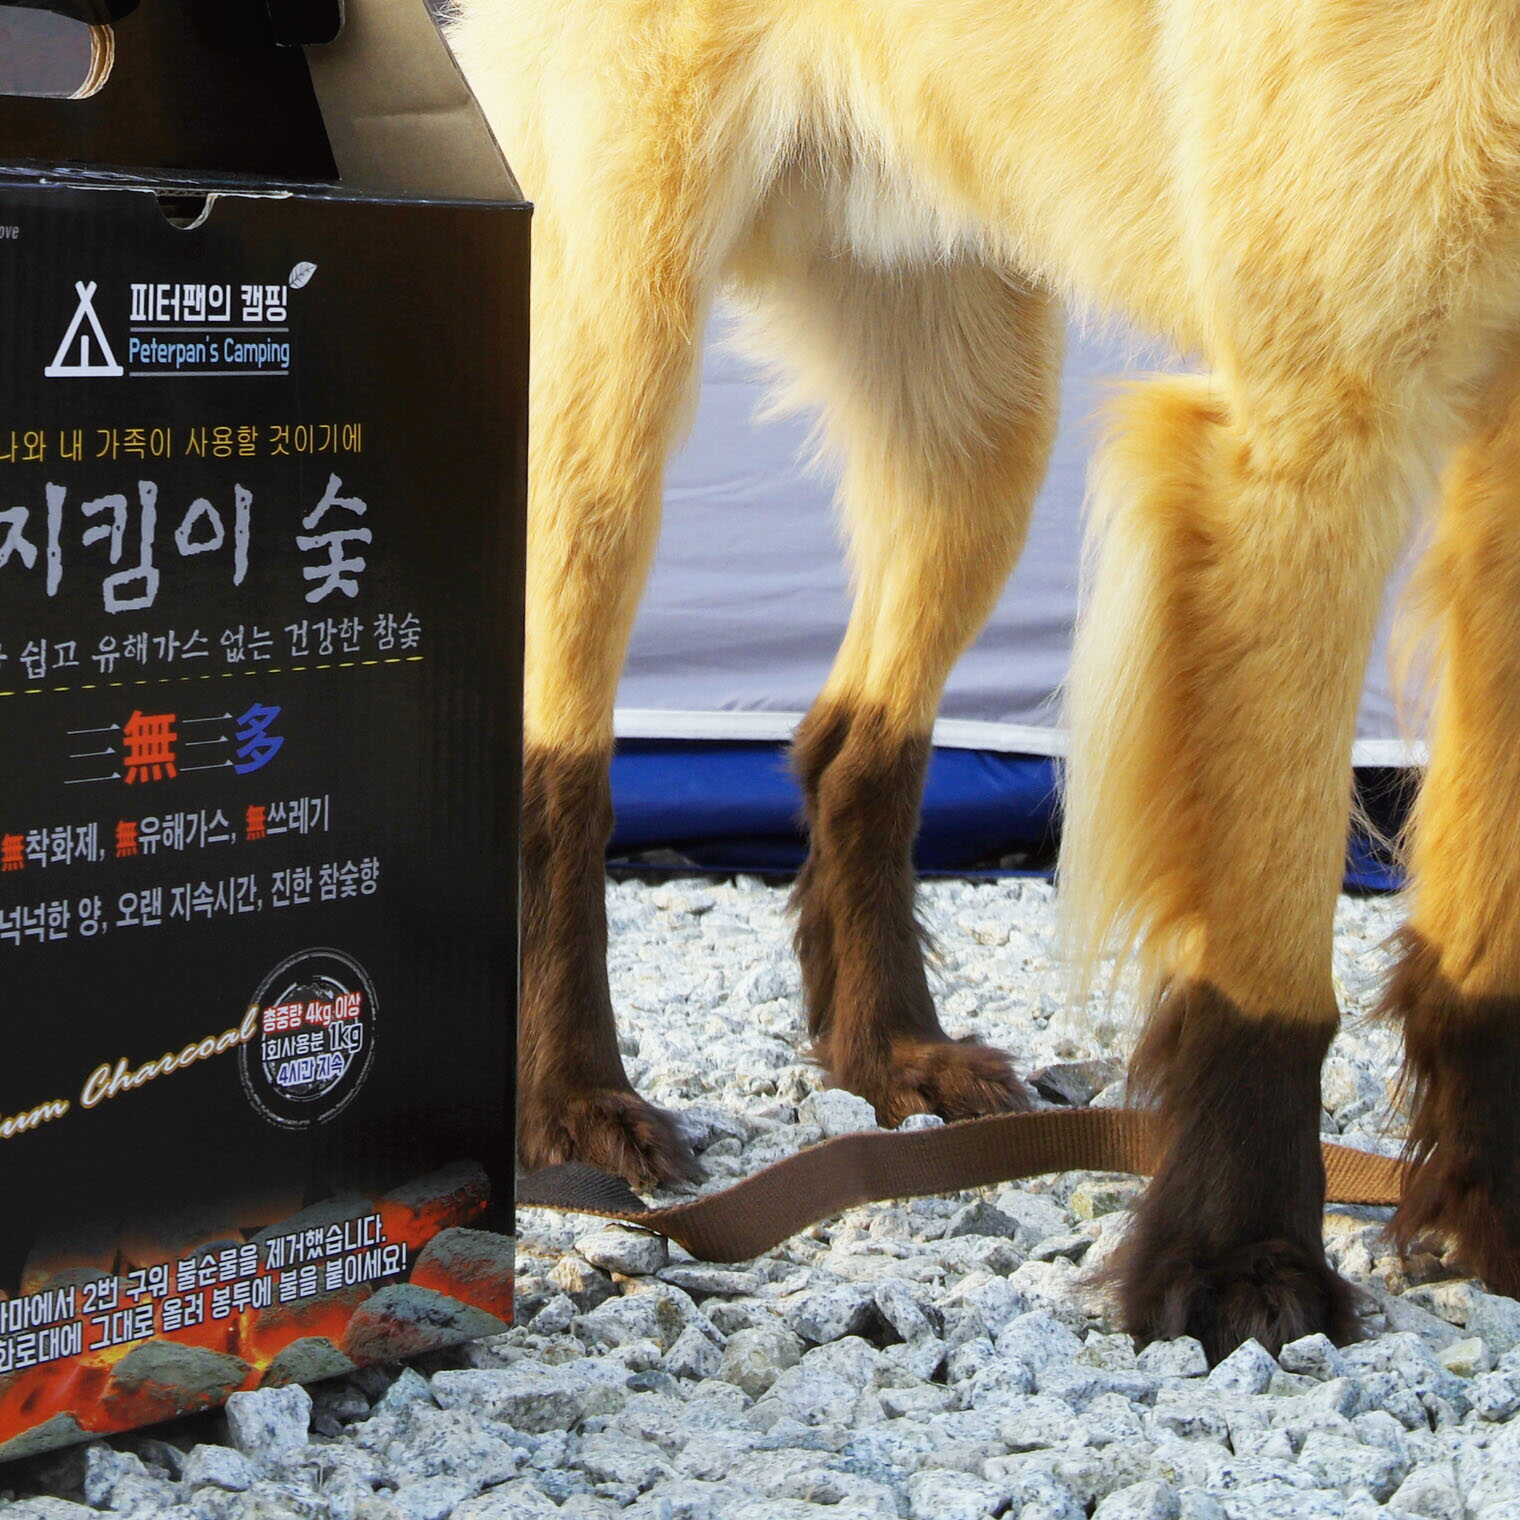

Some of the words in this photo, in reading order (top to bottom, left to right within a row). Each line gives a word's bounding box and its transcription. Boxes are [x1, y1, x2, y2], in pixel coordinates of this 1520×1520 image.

[130, 283, 231, 321] 피터팬의
[241, 284, 287, 322] 캠핑
[129, 335, 218, 369] Peterpan's
[223, 337, 290, 368] Camping
[60, 430, 82, 461] 내
[96, 427, 171, 460] 가족이
[185, 426, 258, 458] 사용할
[269, 423, 361, 456] 것이기에
[295, 471, 373, 604] 숯
[20, 638, 80, 679] 쉽고
[91, 631, 209, 674] 유해가스
[220, 624, 273, 663] 없는
[284, 616, 364, 657] 건강한
[373, 611, 422, 650] 참숯
[78, 895, 108, 937] 양,
[116, 886, 162, 927] 오랜
[169, 874, 263, 922] 지속시간,
[271, 866, 313, 908] 진한
[318, 856, 380, 901] 참숯향
[263, 1003, 304, 1033] 총중량
[305, 1000, 332, 1027] 4kg
[334, 991, 362, 1019] 이상
[80, 1003, 260, 1108] Charcoal
[262, 1031, 325, 1062] 1회사용분
[327, 1022, 364, 1055] 1kg
[276, 1055, 315, 1087] 4시간
[315, 1051, 346, 1082] 지속
[82, 1275, 119, 1315] 2번
[126, 1264, 169, 1303] 구워
[177, 1243, 258, 1293] 불순물을
[265, 1214, 387, 1271] 제거했습니다.
[89, 1302, 155, 1350] 그대로
[162, 1291, 204, 1332] 올려
[211, 1275, 272, 1320] 봉투에
[279, 1264, 317, 1303] 불을
[325, 1241, 408, 1291] 붙이세요!
